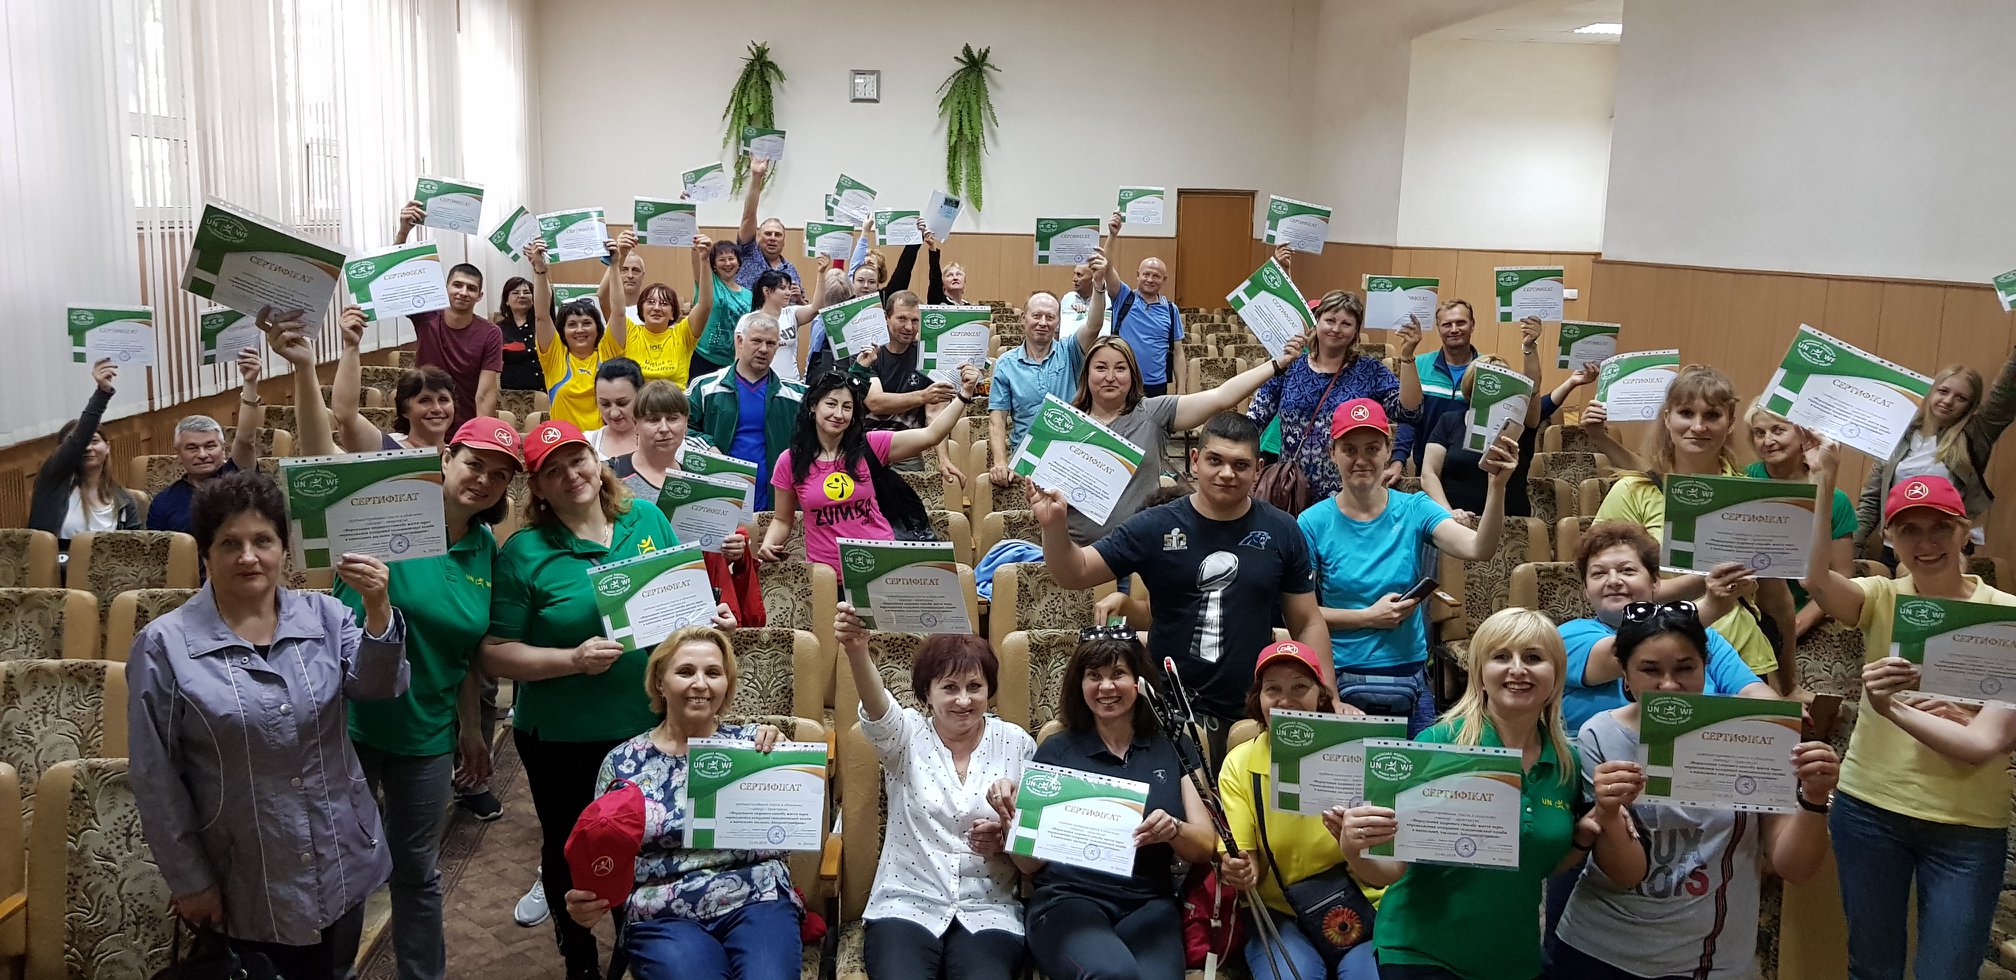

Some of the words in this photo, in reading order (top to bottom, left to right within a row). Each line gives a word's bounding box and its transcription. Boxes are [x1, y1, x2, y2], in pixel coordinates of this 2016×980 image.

[249, 256, 314, 284] СЕРТИФІКАТ
[1798, 342, 1809, 350] UN
[1832, 379, 1894, 408] СЕРТИФІКАТ
[1044, 411, 1053, 419] UN
[1069, 445, 1115, 475] СЕРТИФІКАТ
[351, 493, 419, 506] СЕРТИФІКАТ
[810, 497, 871, 526] ZUMBA
[1722, 513, 1789, 524] СЕРТИФІКАТ
[642, 579, 691, 598] СЕРТИФІКАТ
[1702, 732, 1774, 745] СЕРТИФІКАТ
[740, 783, 801, 792] СЕРТИФІКАТ
[1422, 788, 1494, 802] СЕРТИФІКАТ
[1065, 805, 1121, 821] СЕРТИФІКАТ
